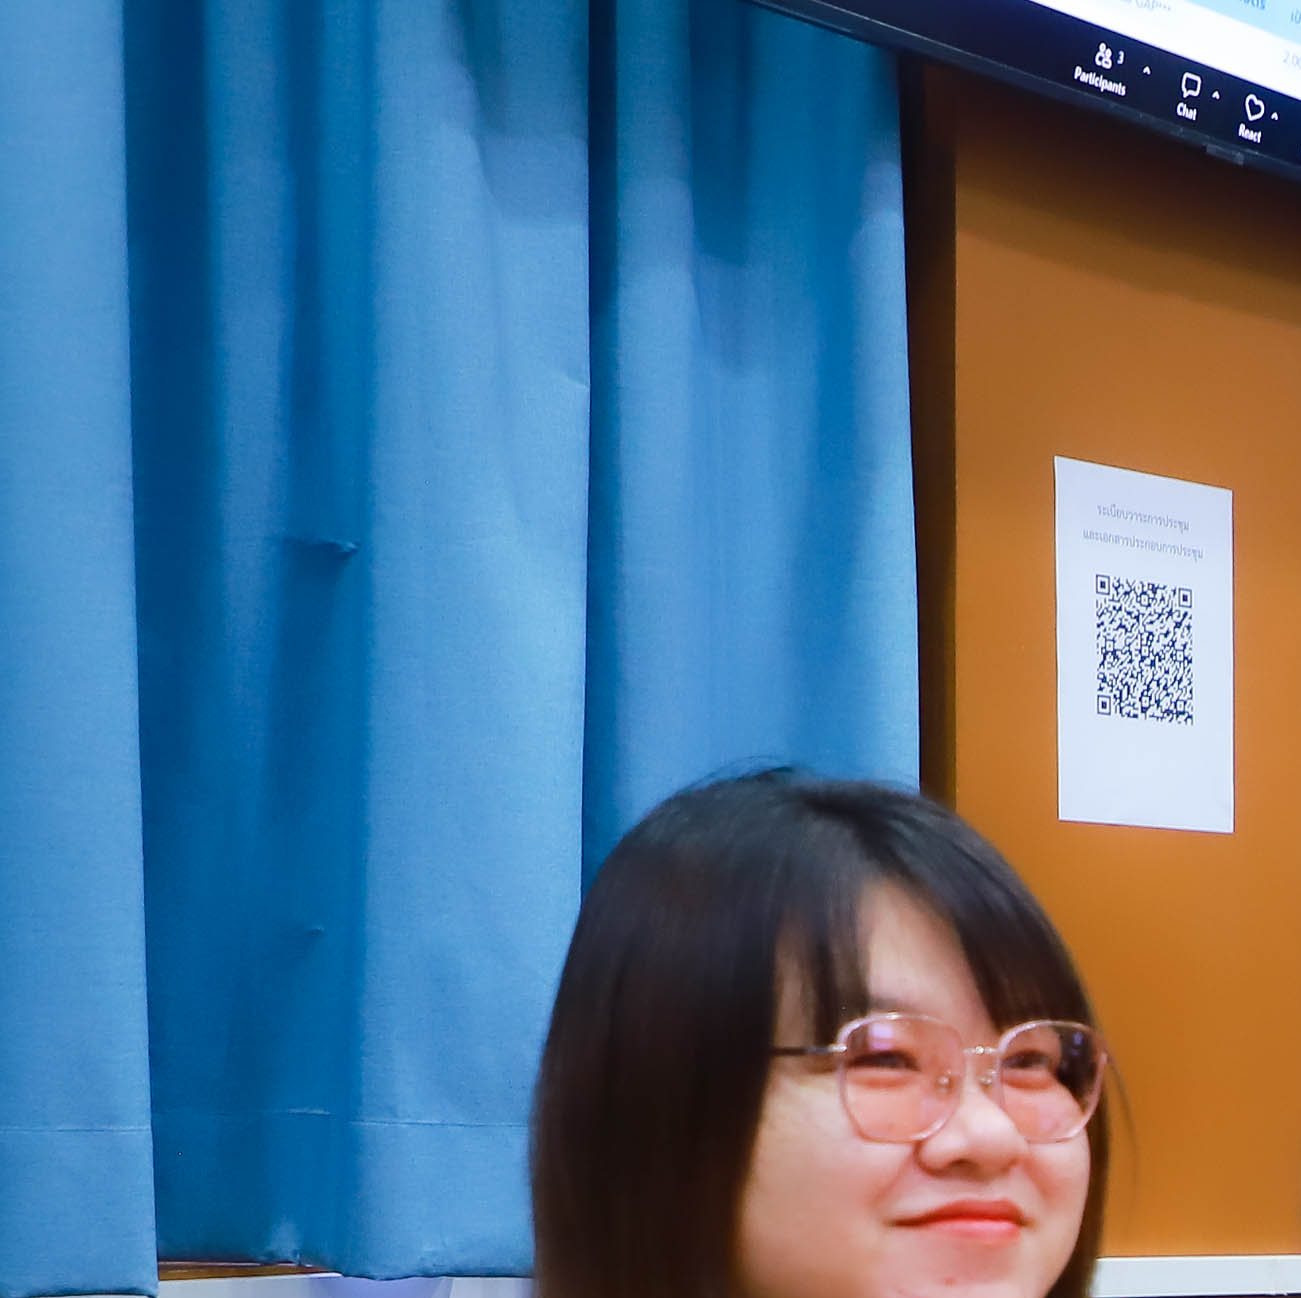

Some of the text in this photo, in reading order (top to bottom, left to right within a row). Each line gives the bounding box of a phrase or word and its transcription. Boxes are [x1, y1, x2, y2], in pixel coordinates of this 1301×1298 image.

[1117, 50, 1125, 65] 3
[1073, 65, 1127, 97] Participants
[1176, 102, 1198, 121] Chat
[1238, 123, 1262, 144] React
[1096, 504, 1190, 534] ระเบียบวาระการประชุม
[1082, 529, 1204, 563] และเอกสารประกอบการประชุม
